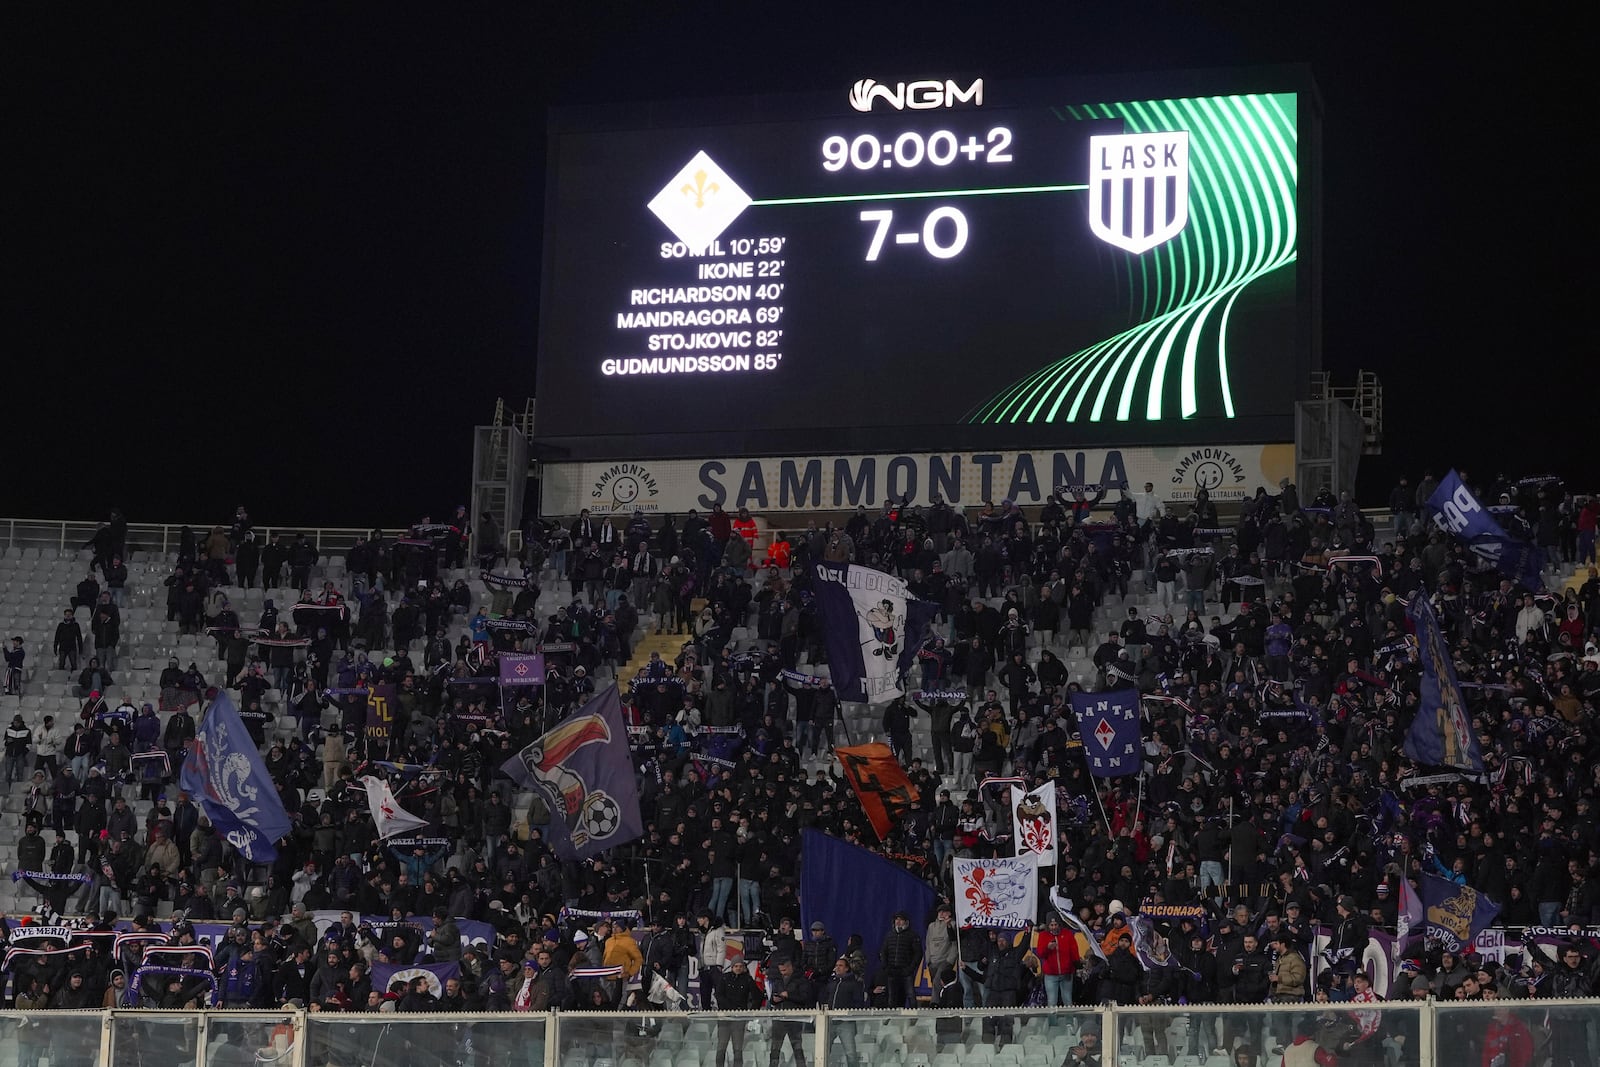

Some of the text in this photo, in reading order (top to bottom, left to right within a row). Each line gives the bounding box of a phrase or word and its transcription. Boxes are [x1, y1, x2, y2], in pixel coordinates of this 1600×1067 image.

[868, 78, 984, 110] NGM
[822, 127, 1014, 172] 90:00+2
[859, 206, 969, 262] 7-0
[660, 240, 726, 259] SOIL
[698, 260, 785, 280] IKONE 22'
[631, 283, 785, 305] RICHARDSON 40'
[616, 306, 784, 329] MANDRAGORA 69'
[648, 330, 784, 351] STOJKOVIC 82'
[600, 353, 783, 376] GUDMUNDSSON 85'
[1171, 447, 1246, 484] SAMMONTANA
[591, 463, 659, 498] SAMMONTANA
[697, 449, 1130, 510] SAMMONTANA
[1171, 490, 1246, 499] GELATI LL'ITALIANA
[367, 685, 393, 722] ZTL
[14, 928, 34, 938] UVE
[969, 916, 1026, 928] COLLETTIVO
